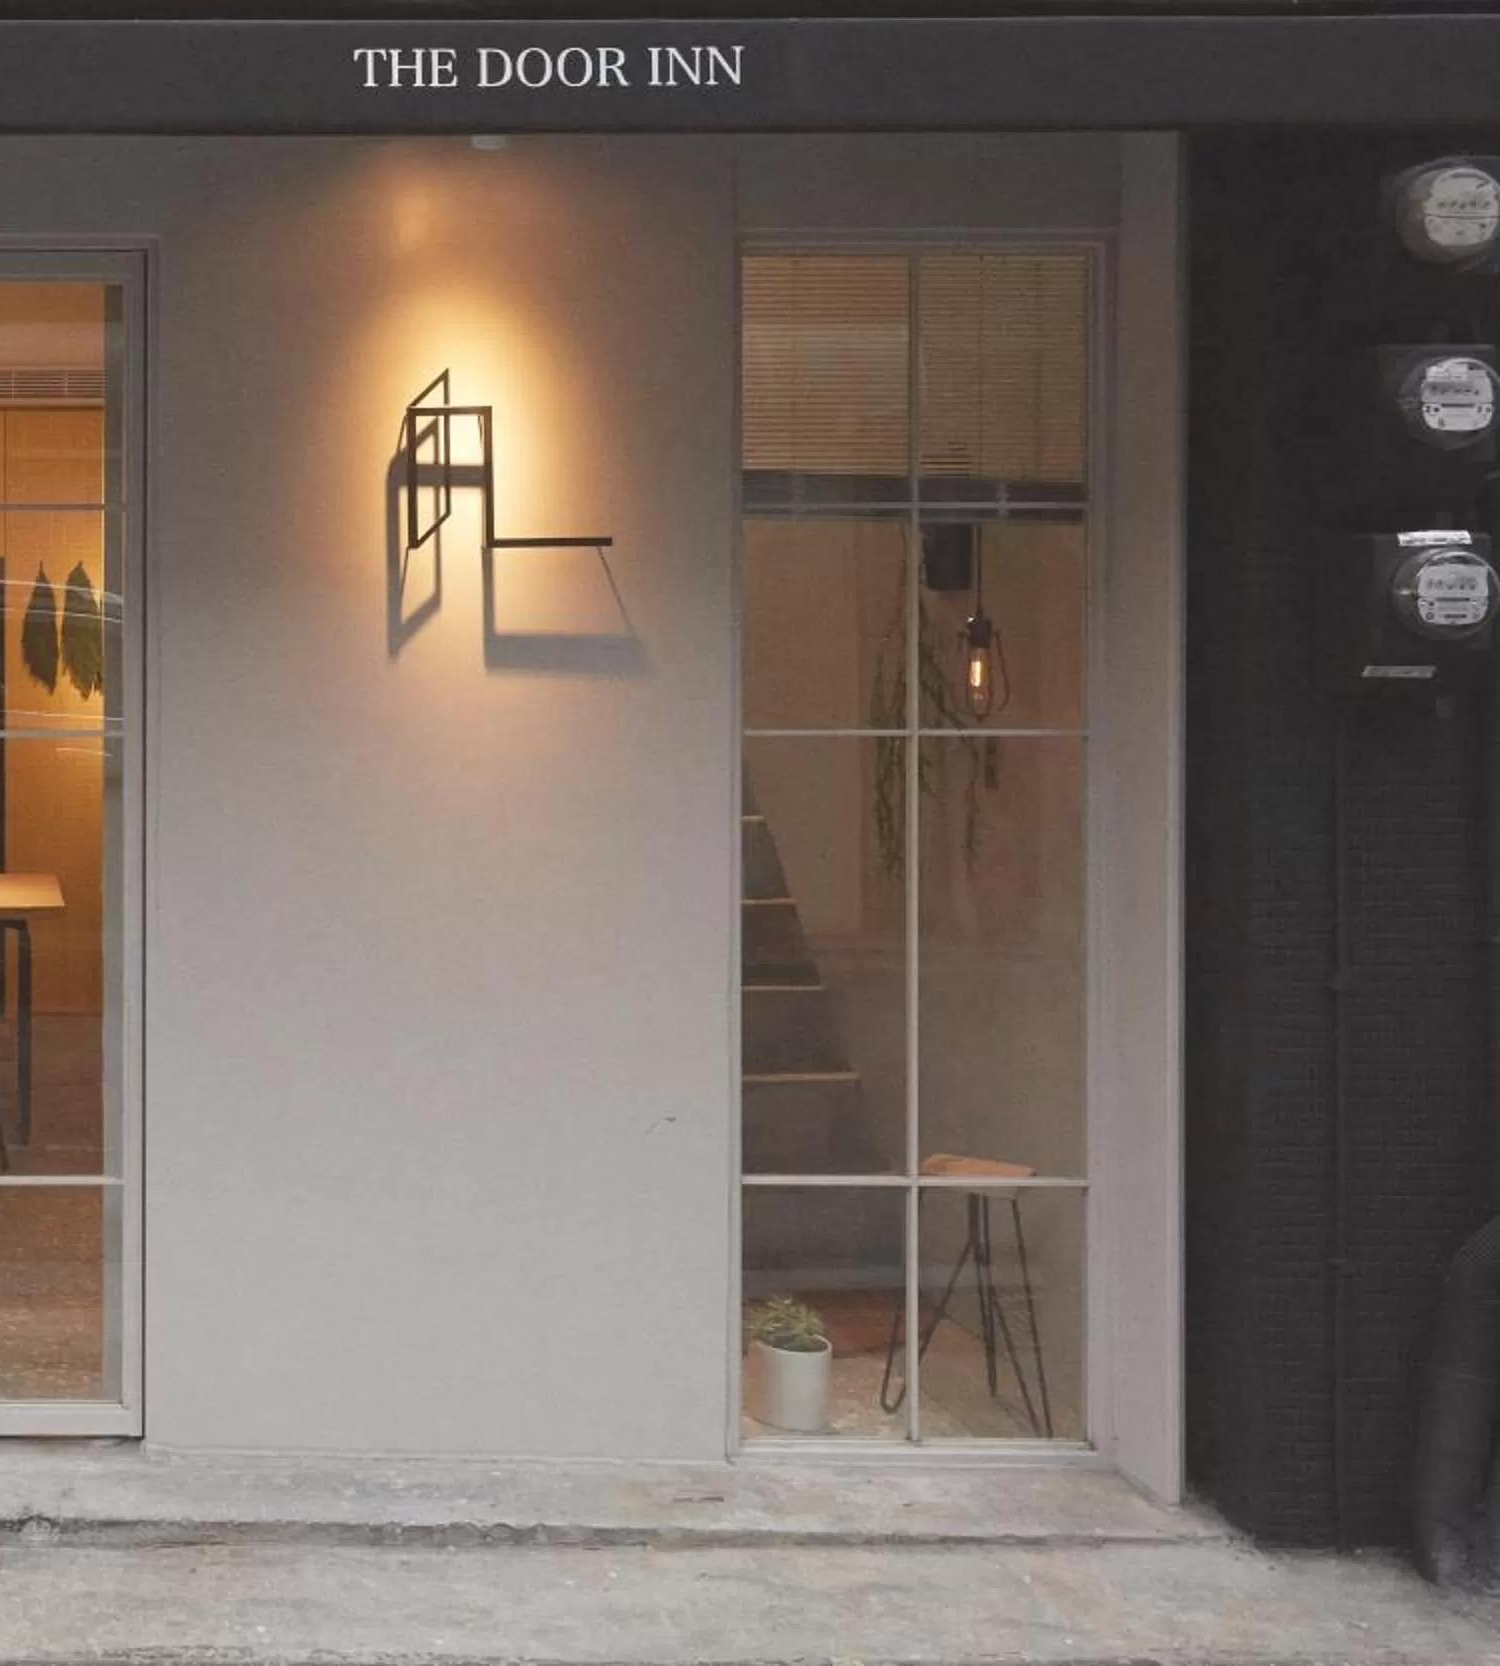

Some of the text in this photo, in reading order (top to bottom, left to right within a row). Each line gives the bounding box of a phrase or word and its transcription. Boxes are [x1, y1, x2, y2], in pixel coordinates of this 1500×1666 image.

[353, 45, 745, 87] THE DOOR INN
